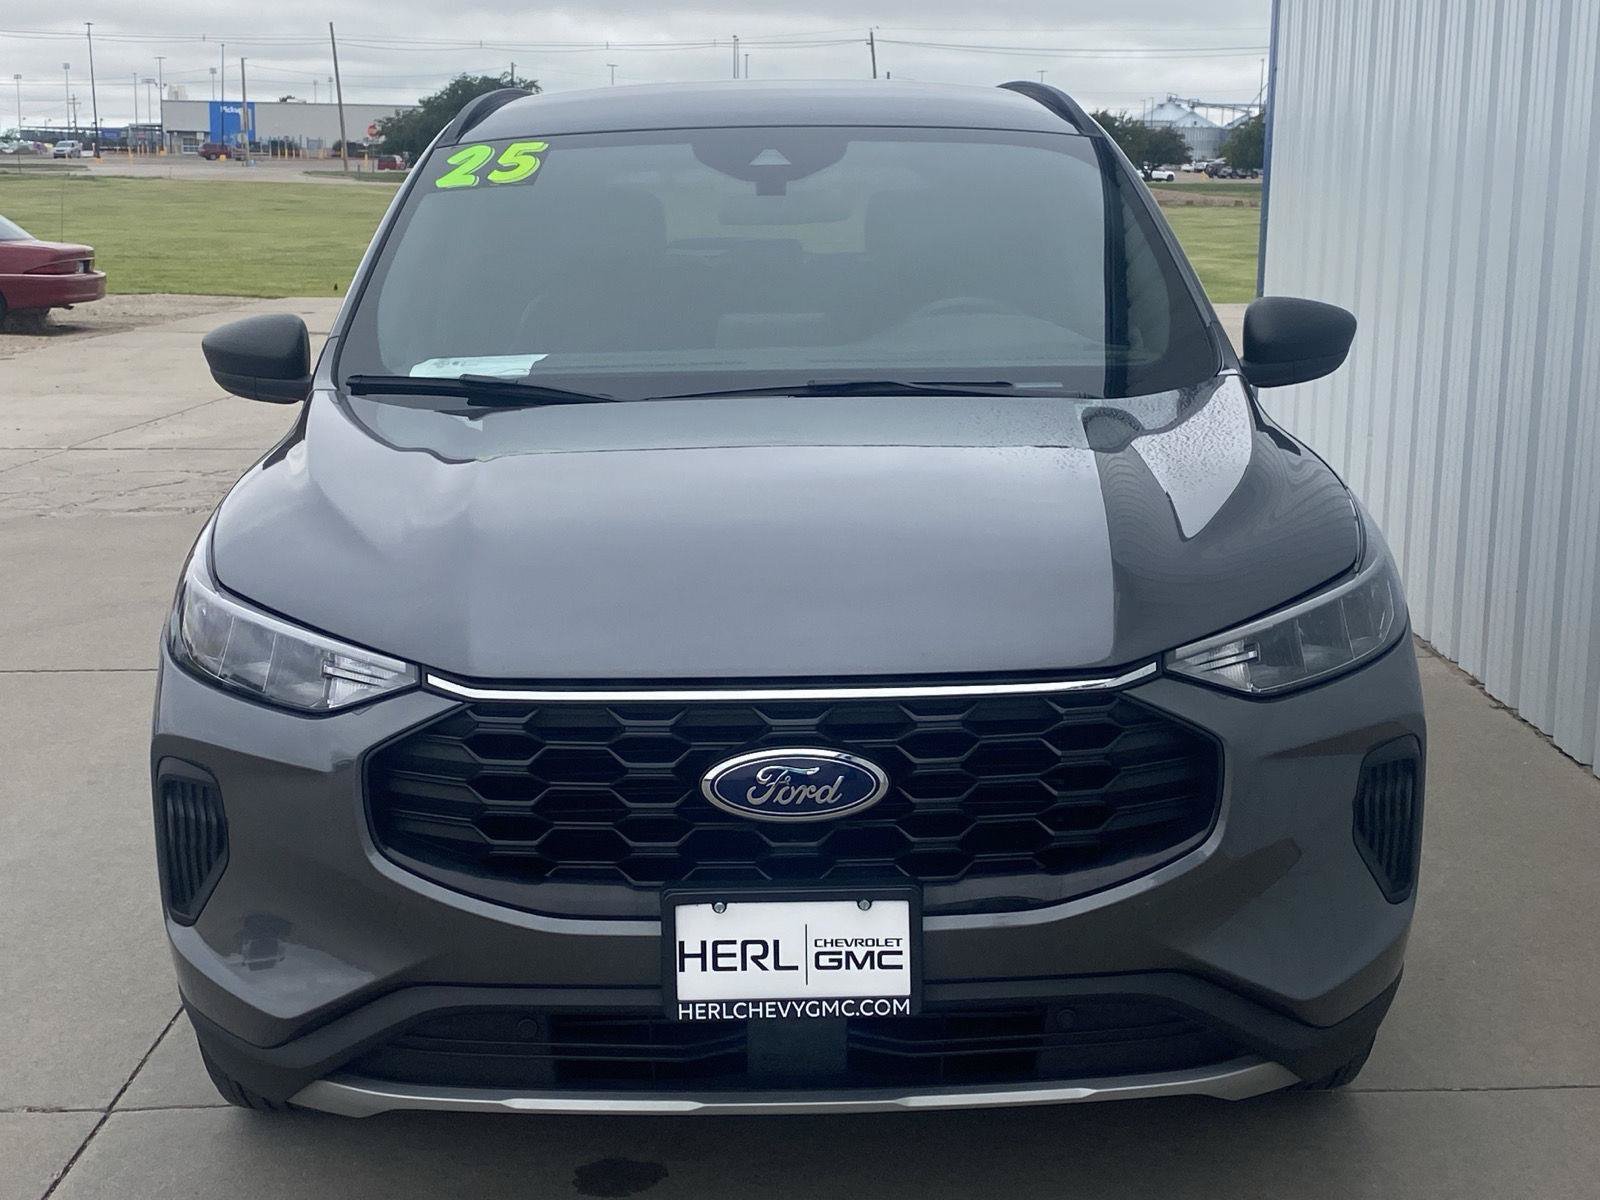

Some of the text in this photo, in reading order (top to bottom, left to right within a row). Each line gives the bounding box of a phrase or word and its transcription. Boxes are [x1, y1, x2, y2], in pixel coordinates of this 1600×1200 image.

[435, 141, 549, 189] 25
[746, 766, 845, 805] Ford
[678, 939, 799, 972] HERL
[814, 938, 903, 948] CHEVROLET
[814, 950, 903, 970] GMC
[678, 998, 910, 1020] HERLCHEVYGMC.COM
